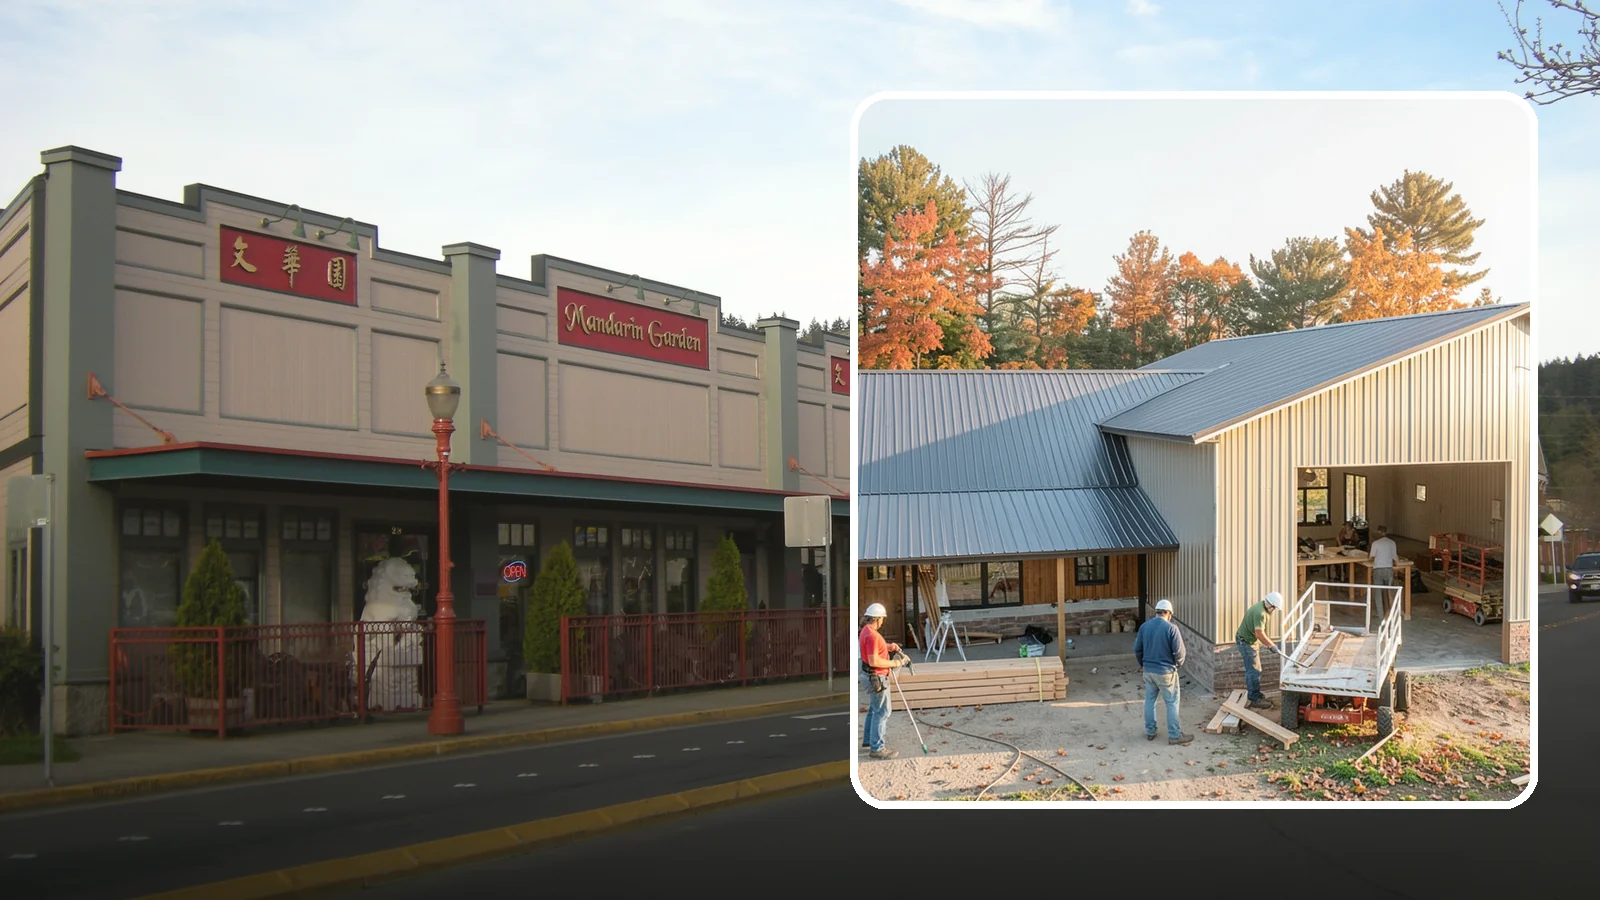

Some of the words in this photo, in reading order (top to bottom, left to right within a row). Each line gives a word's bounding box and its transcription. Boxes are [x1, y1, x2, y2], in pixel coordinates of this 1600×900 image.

[230, 235, 347, 291] 文華園
[564, 302, 644, 341] Mandarin
[647, 320, 702, 353] Garden
[503, 564, 527, 578] OPEN
